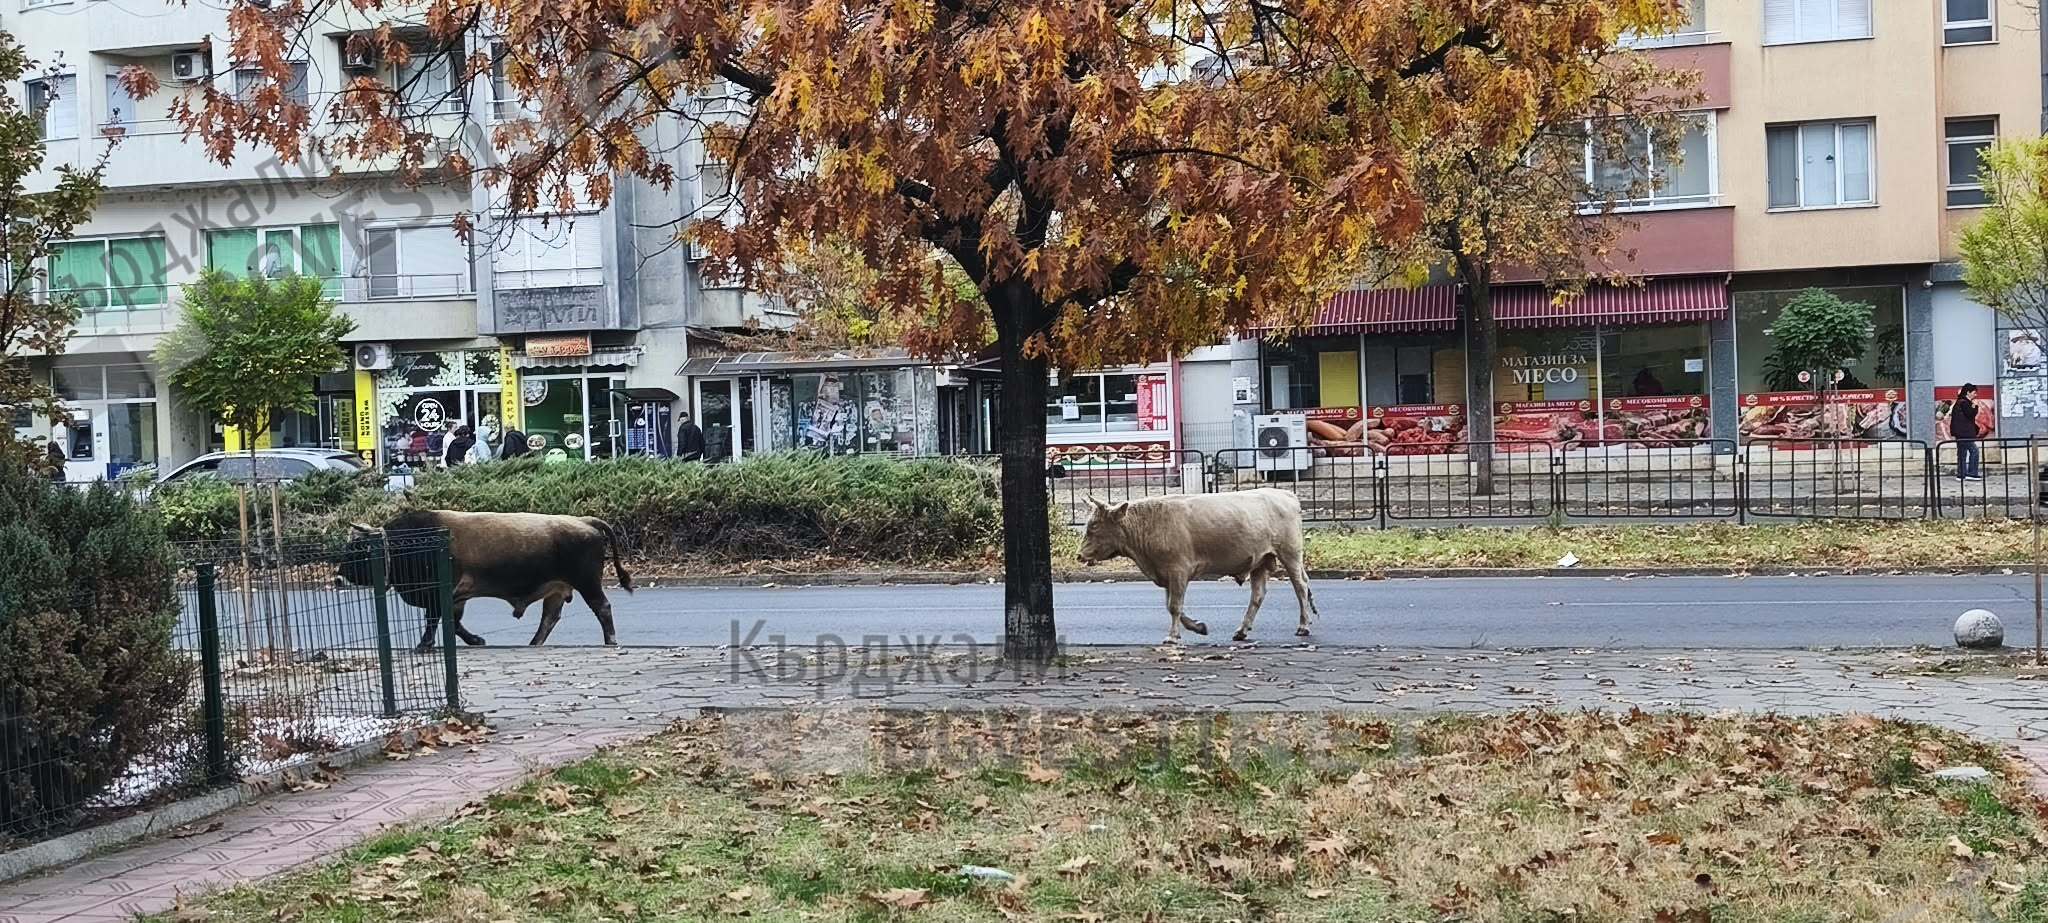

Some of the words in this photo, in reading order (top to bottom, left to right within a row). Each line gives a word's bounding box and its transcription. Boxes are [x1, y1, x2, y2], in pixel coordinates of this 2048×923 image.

[1502, 355, 1567, 367] МАГАЗИН
[1571, 354, 1587, 365] ЗА
[1512, 367, 1578, 384] МЕСО
[1626, 397, 1686, 405] МЕСОКОМБИНАТ
[420, 408, 440, 422] 24
